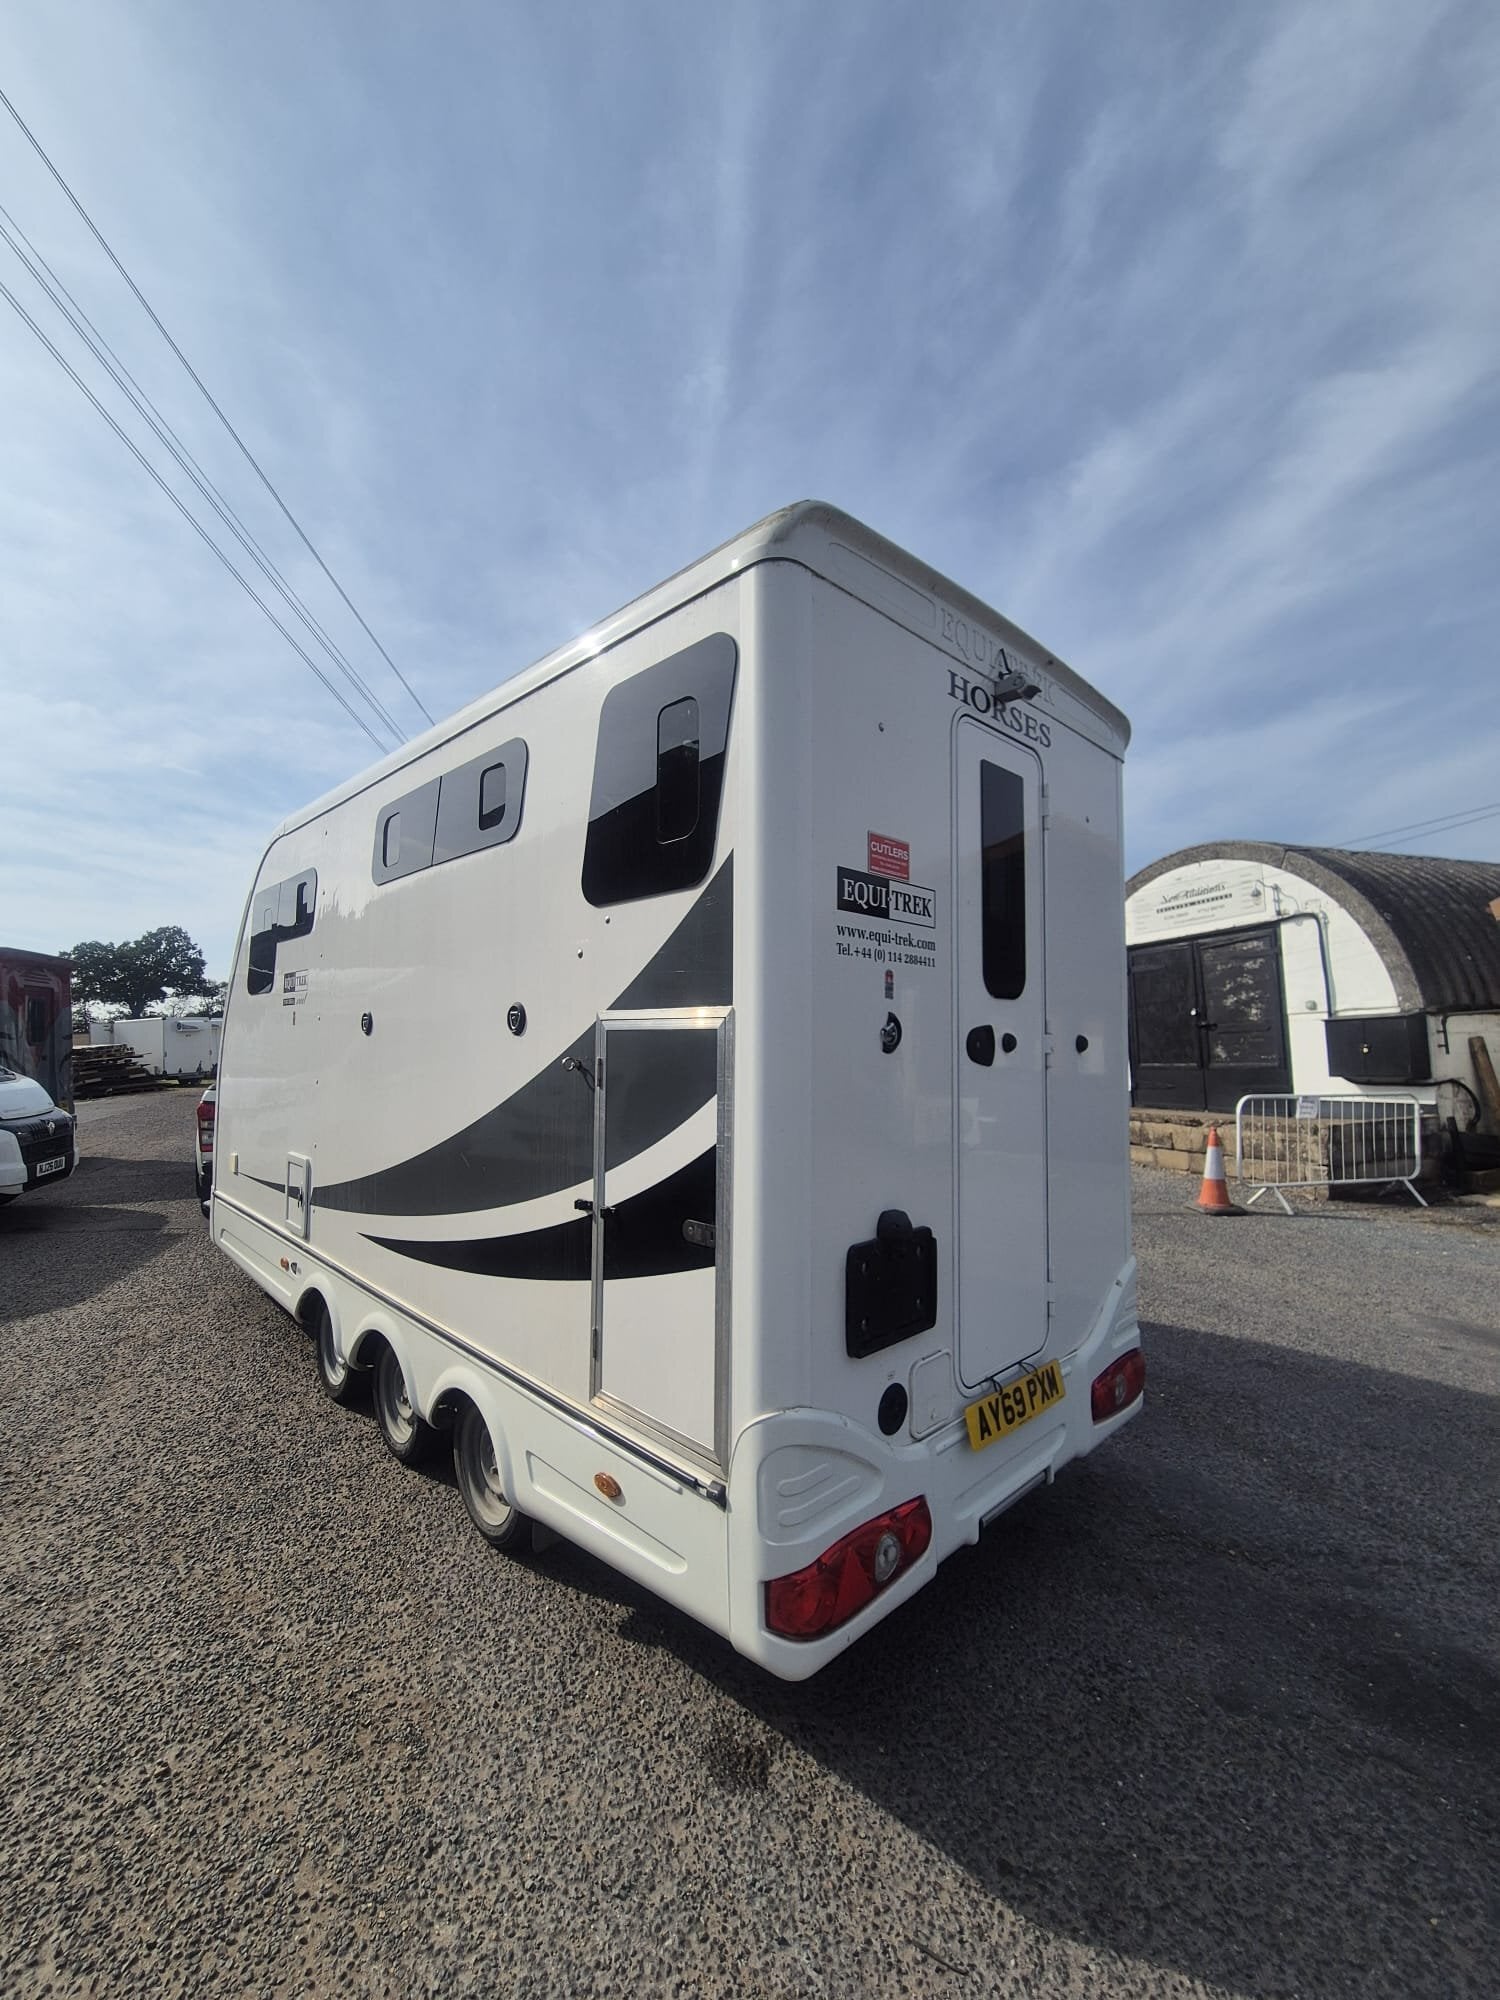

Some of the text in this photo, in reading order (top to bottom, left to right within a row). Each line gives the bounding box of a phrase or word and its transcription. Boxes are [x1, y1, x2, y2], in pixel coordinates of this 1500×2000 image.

[947, 669, 1051, 748] HORSES
[871, 841, 908, 861] CUTLERS
[836, 925, 936, 951] www.equi-trek.com
[888, 951, 902, 963] 114
[978, 1365, 1060, 1441] AY69 PXM
